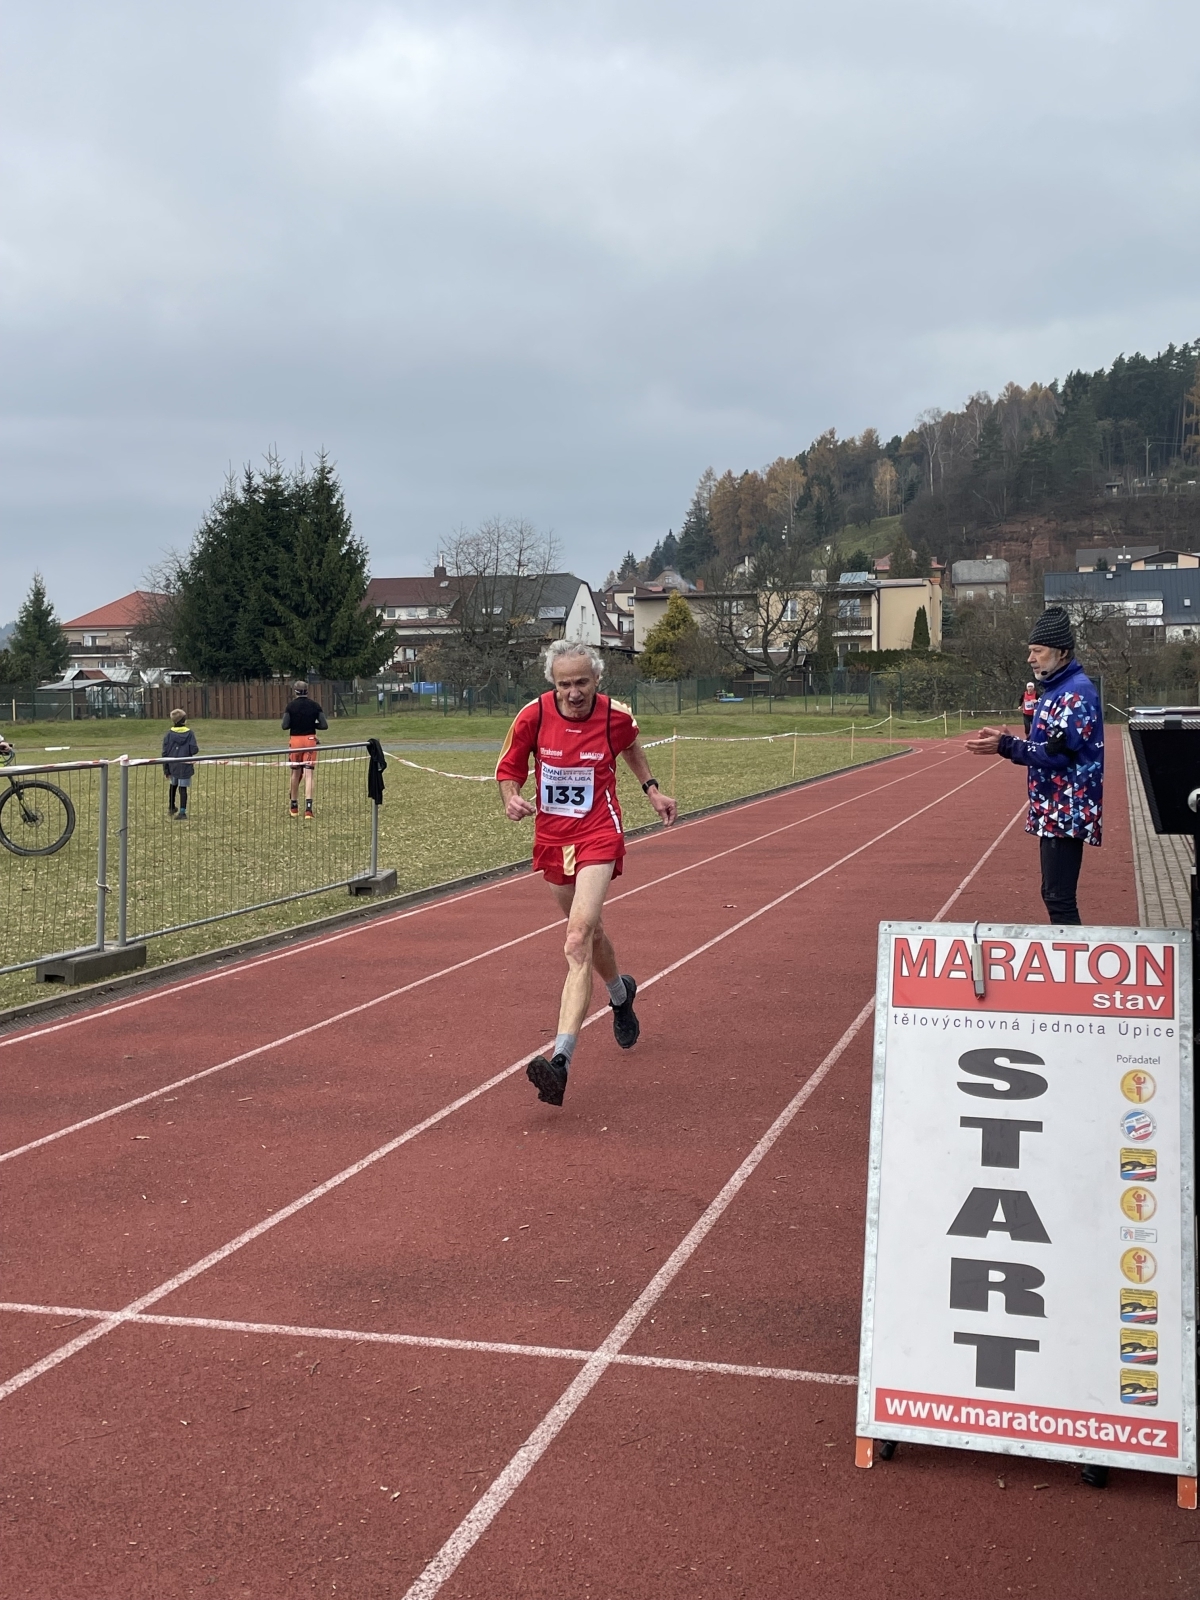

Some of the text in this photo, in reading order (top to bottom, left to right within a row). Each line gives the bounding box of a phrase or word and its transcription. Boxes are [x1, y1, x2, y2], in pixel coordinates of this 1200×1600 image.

[545, 785, 585, 805] 133
[893, 938, 1174, 987] MARATON
[1092, 990, 1165, 1011] stav
[894, 1013, 1175, 1038] tělovýchovná jednota Úpice
[1116, 1054, 1161, 1065] Pořadatel
[946, 1048, 1052, 1392] START
[885, 1397, 1168, 1448] www.maratonstav.cz
